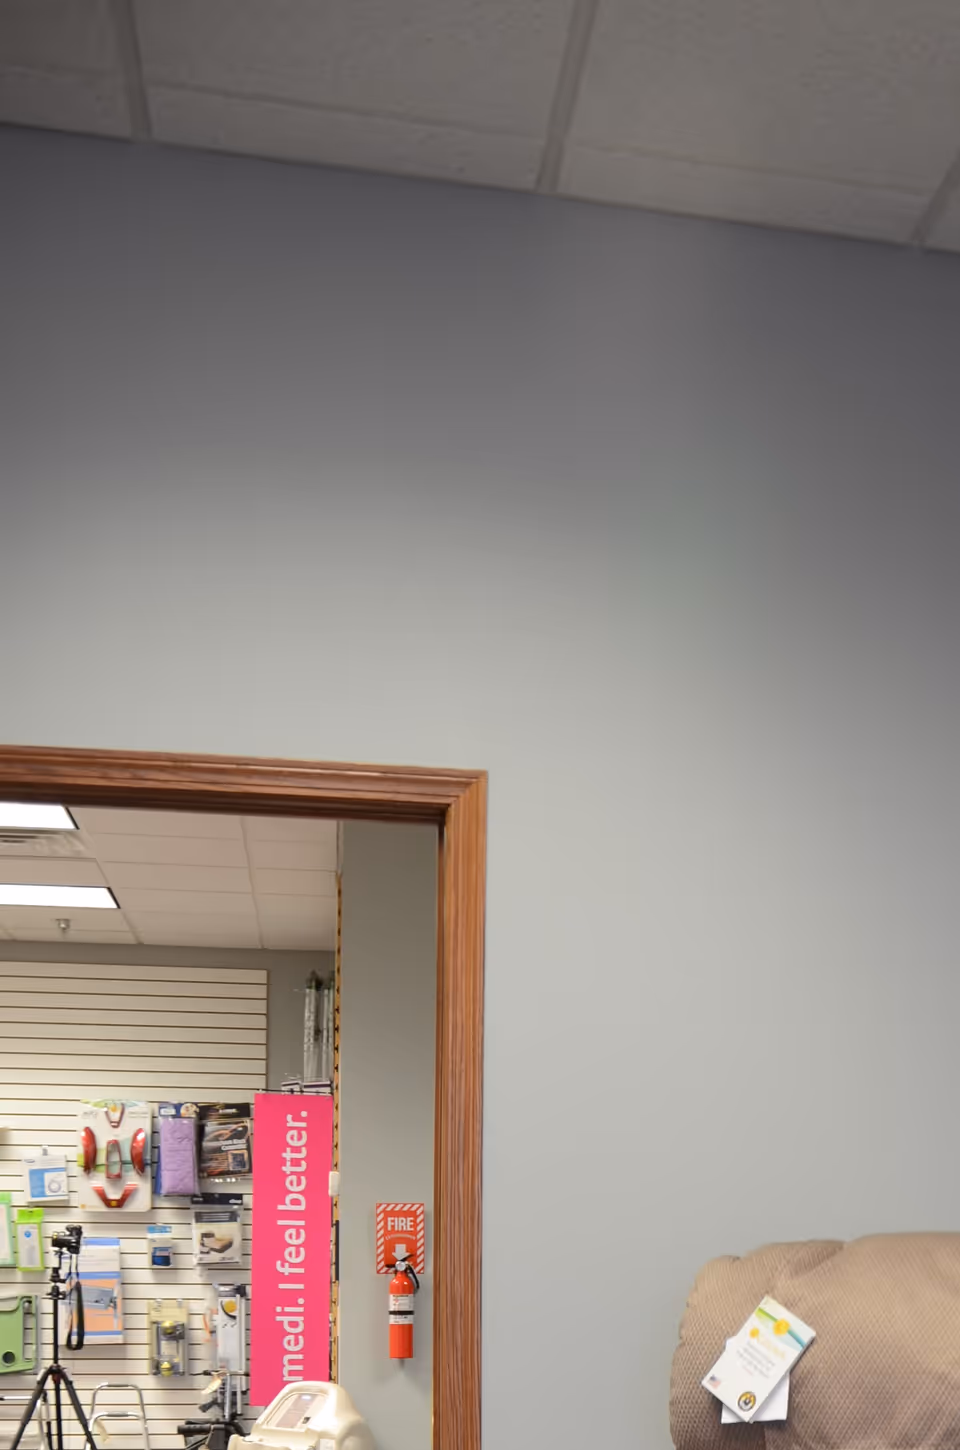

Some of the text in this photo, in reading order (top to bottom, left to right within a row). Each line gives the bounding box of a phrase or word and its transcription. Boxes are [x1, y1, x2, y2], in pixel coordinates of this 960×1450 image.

[277, 1110, 308, 1211] better.
[276, 1221, 306, 1275] feel
[387, 1217, 415, 1232] FIRE
[275, 1297, 305, 1381] medi.
